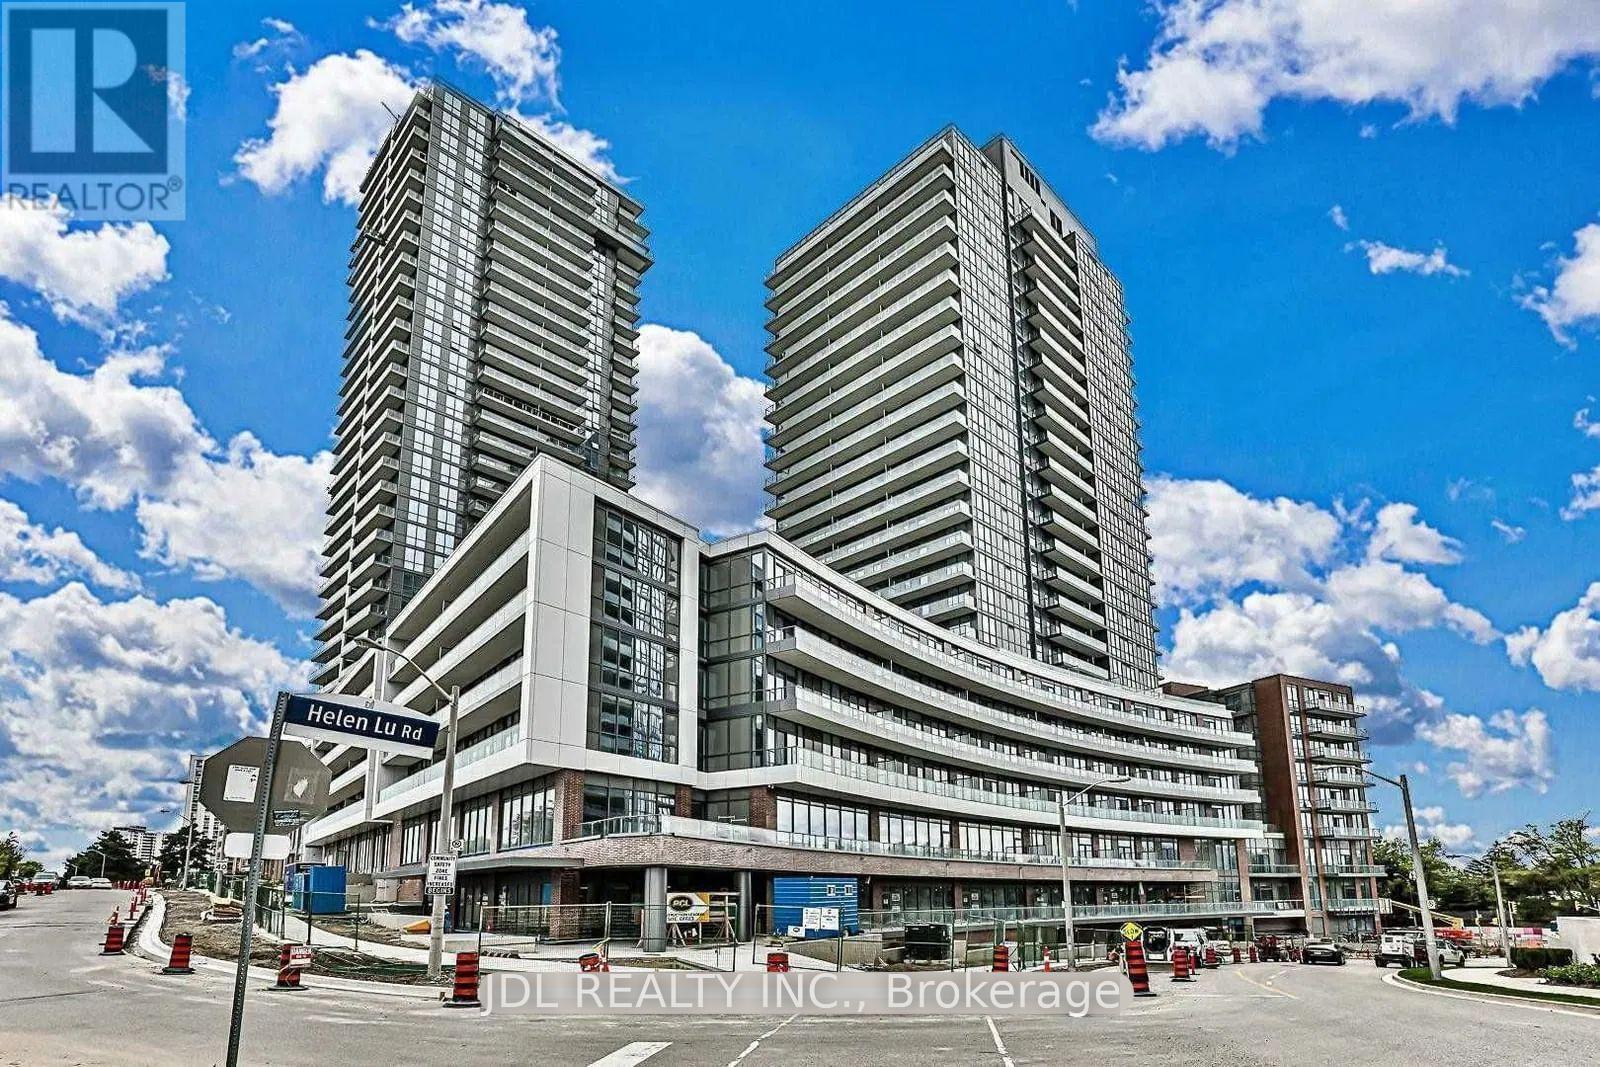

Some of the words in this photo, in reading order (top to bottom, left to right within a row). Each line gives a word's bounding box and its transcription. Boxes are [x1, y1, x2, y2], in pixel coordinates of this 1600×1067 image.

[307, 703, 369, 731] Helen
[374, 716, 397, 736] Lu
[401, 724, 423, 741] Rd
